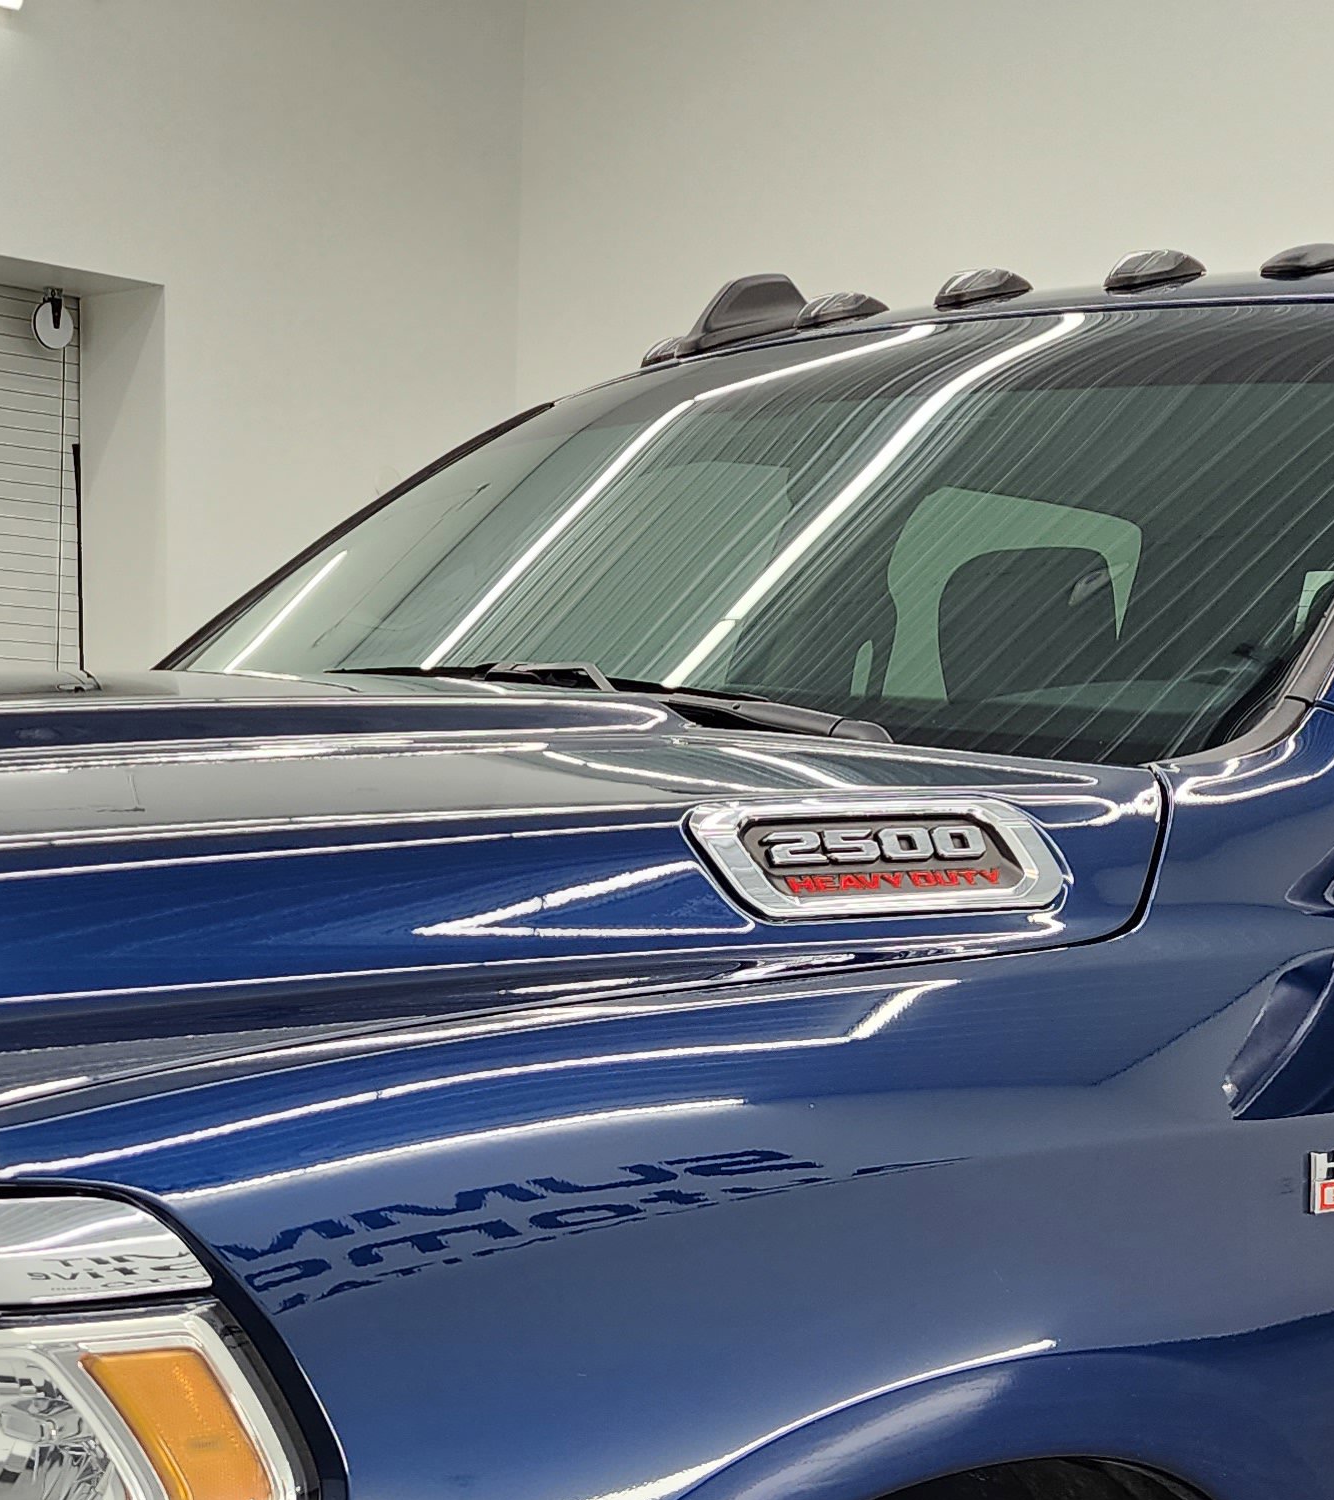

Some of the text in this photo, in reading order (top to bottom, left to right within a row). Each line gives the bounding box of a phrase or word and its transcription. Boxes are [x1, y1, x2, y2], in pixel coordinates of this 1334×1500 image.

[762, 826, 987, 867] 2500
[785, 868, 1001, 894] HEAVY DUTY
